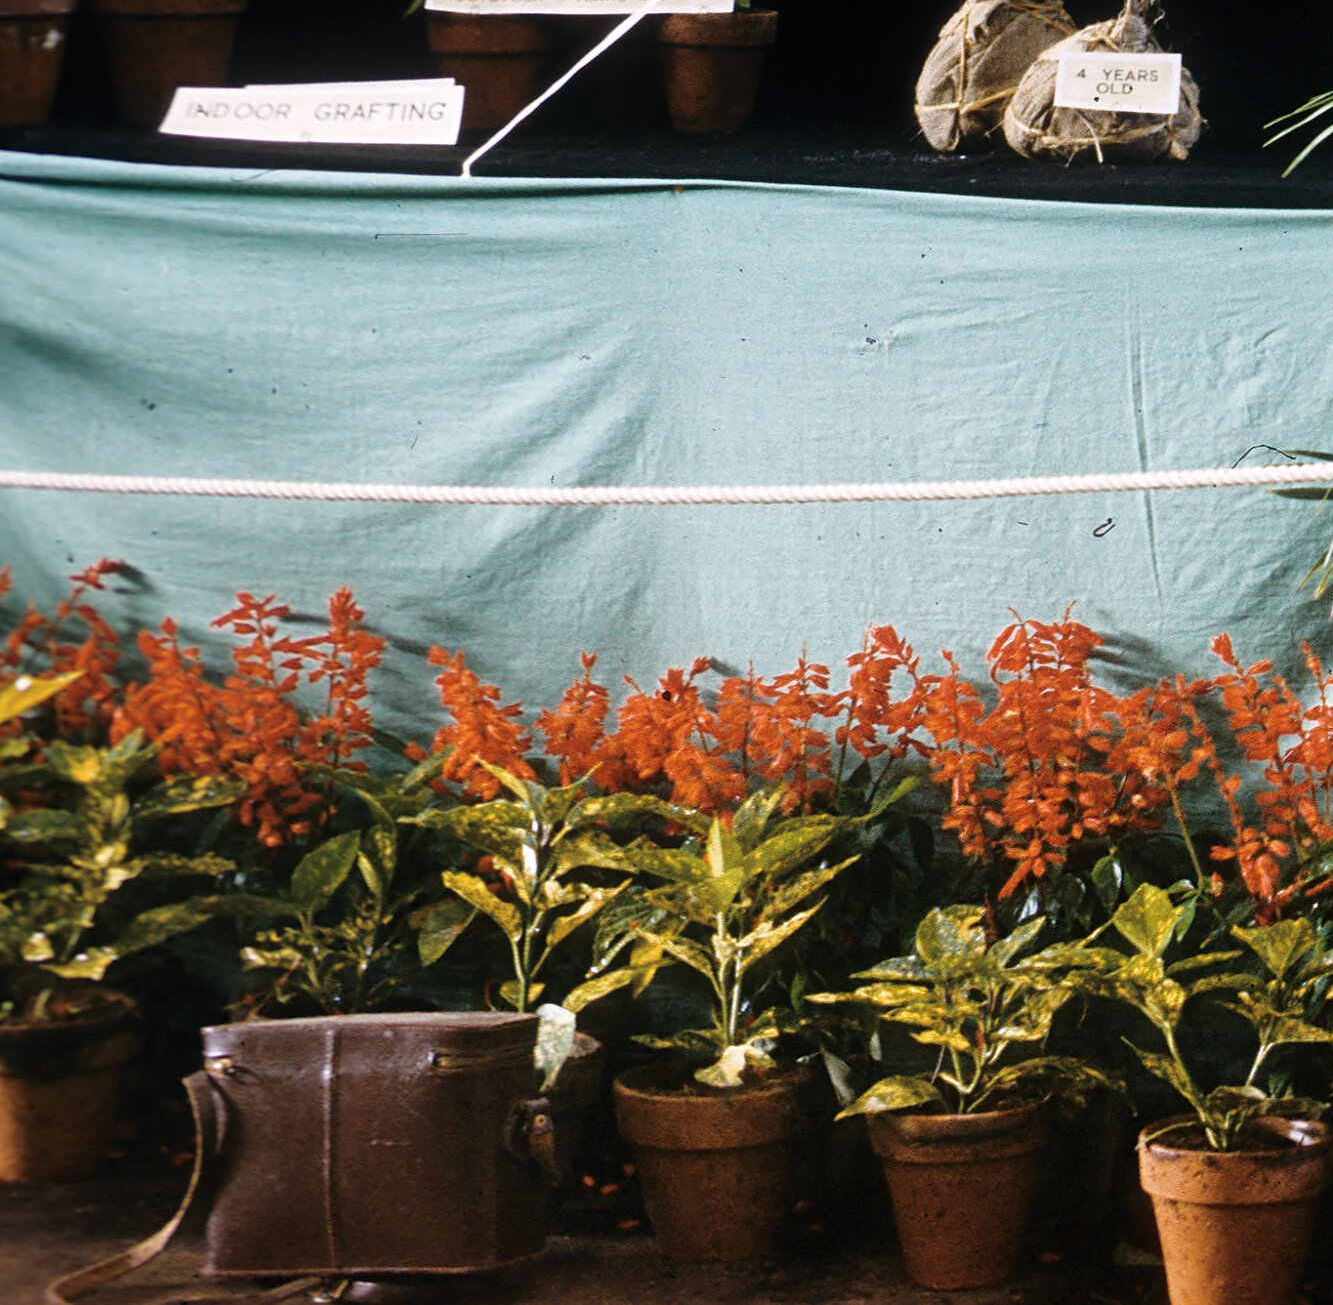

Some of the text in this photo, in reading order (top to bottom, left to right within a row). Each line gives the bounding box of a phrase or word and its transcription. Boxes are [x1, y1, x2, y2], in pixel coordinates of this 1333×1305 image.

[1077, 68, 1159, 82] 4 YEARS
[1096, 83, 1133, 95] OLD
[185, 102, 447, 121] INDOOR GRAFTING
